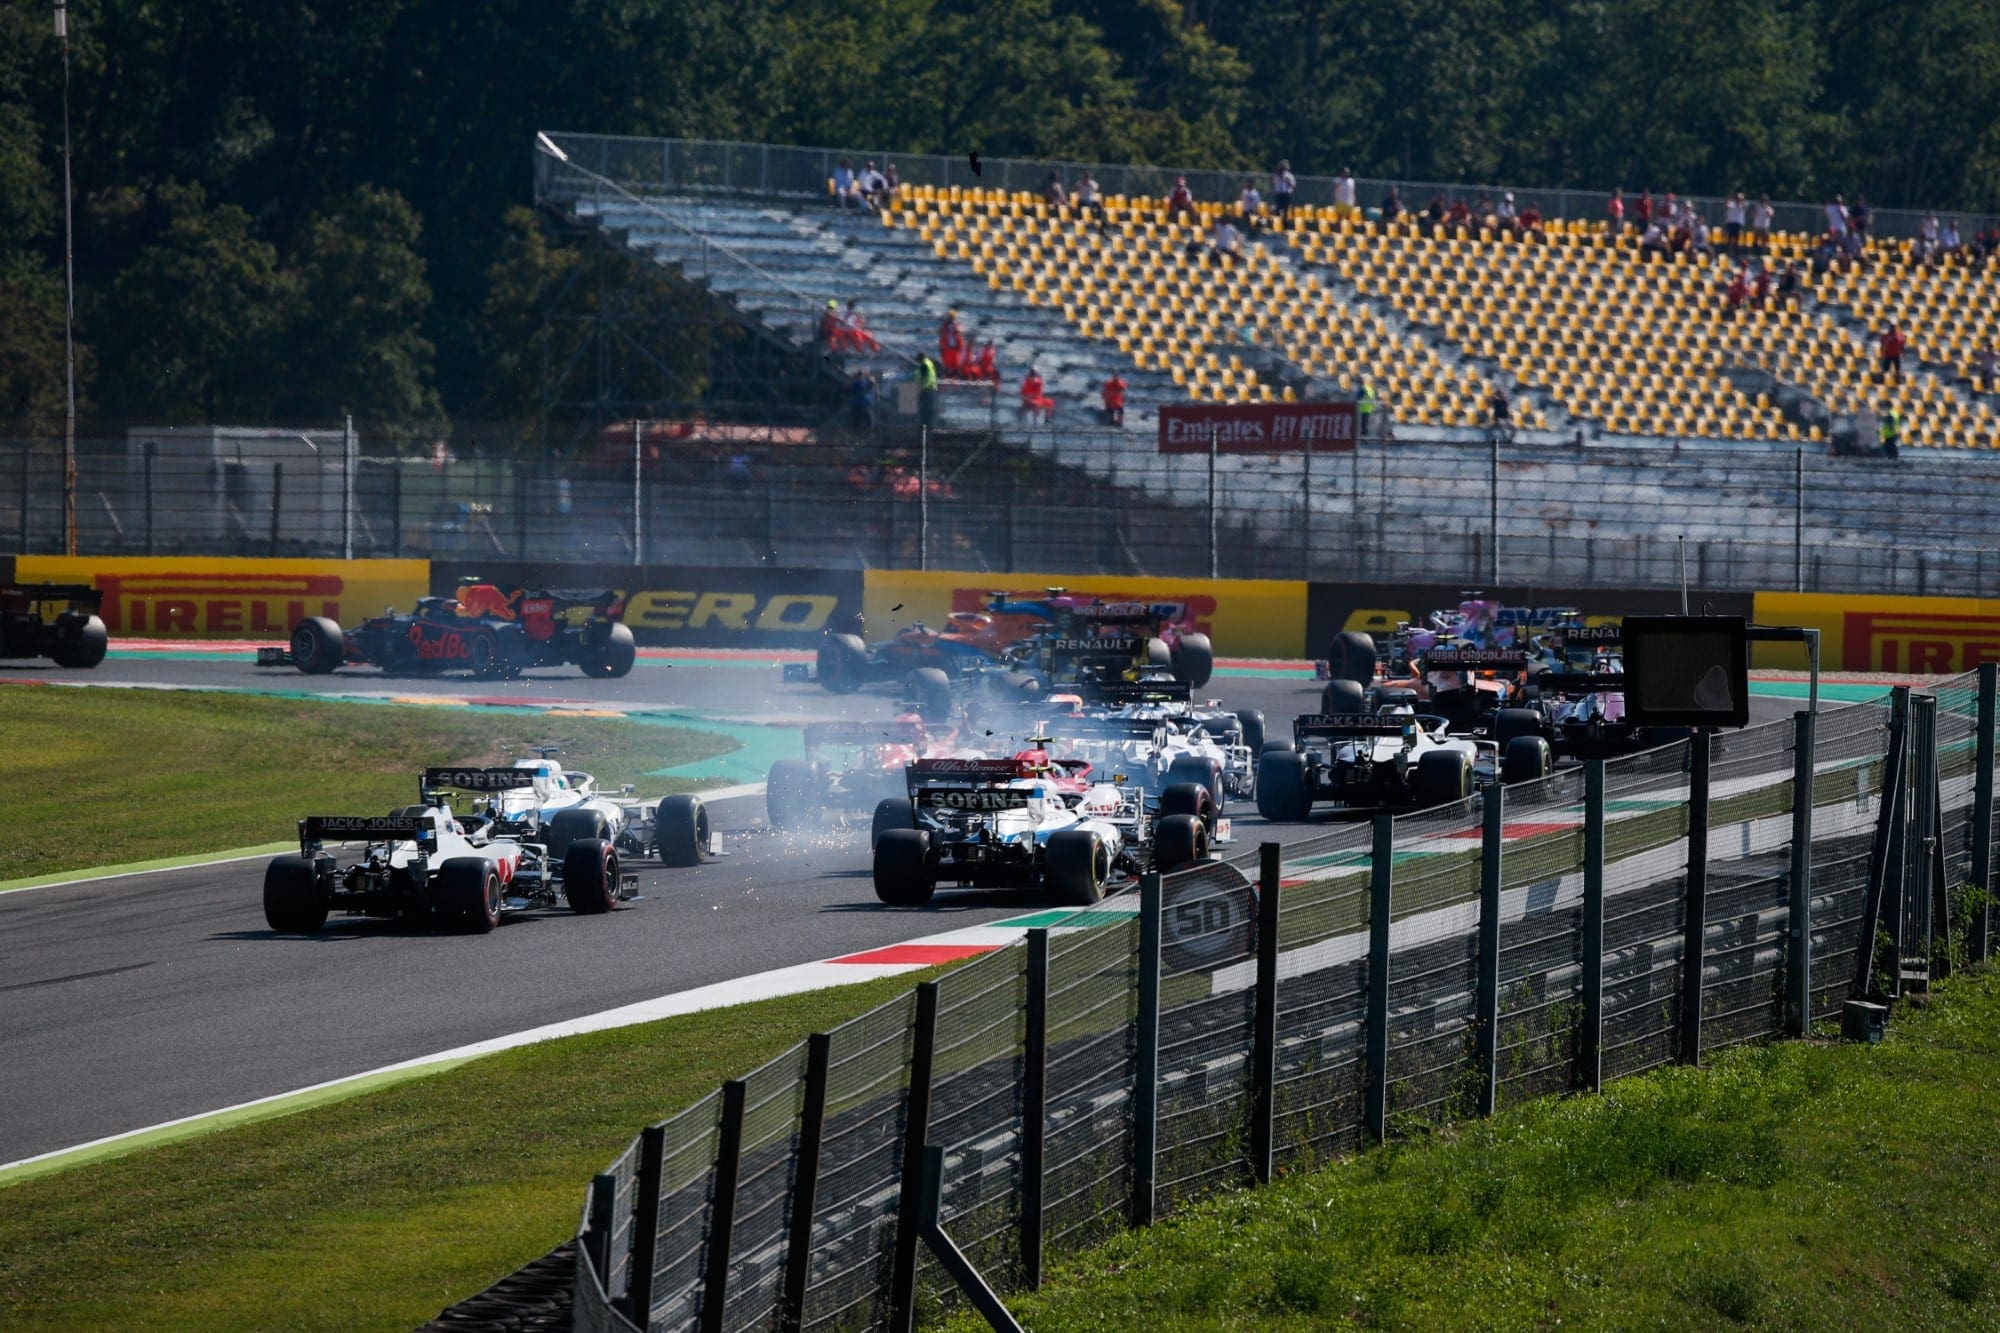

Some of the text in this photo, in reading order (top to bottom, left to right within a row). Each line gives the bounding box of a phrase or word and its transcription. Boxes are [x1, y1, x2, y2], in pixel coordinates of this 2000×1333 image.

[1167, 414, 1353, 443] Emirates FLY BETTER
[95, 573, 344, 633] PIRELLI
[1568, 628, 1620, 640] RENA
[1055, 639, 1135, 649] RENAULT
[1842, 611, 2000, 674] PIRE
[1427, 650, 1521, 661] HUSKI CHOCOLATE
[931, 760, 1009, 772] Alfa Romeo
[438, 772, 534, 788] SOFINA
[930, 792, 1027, 809] SOFINA
